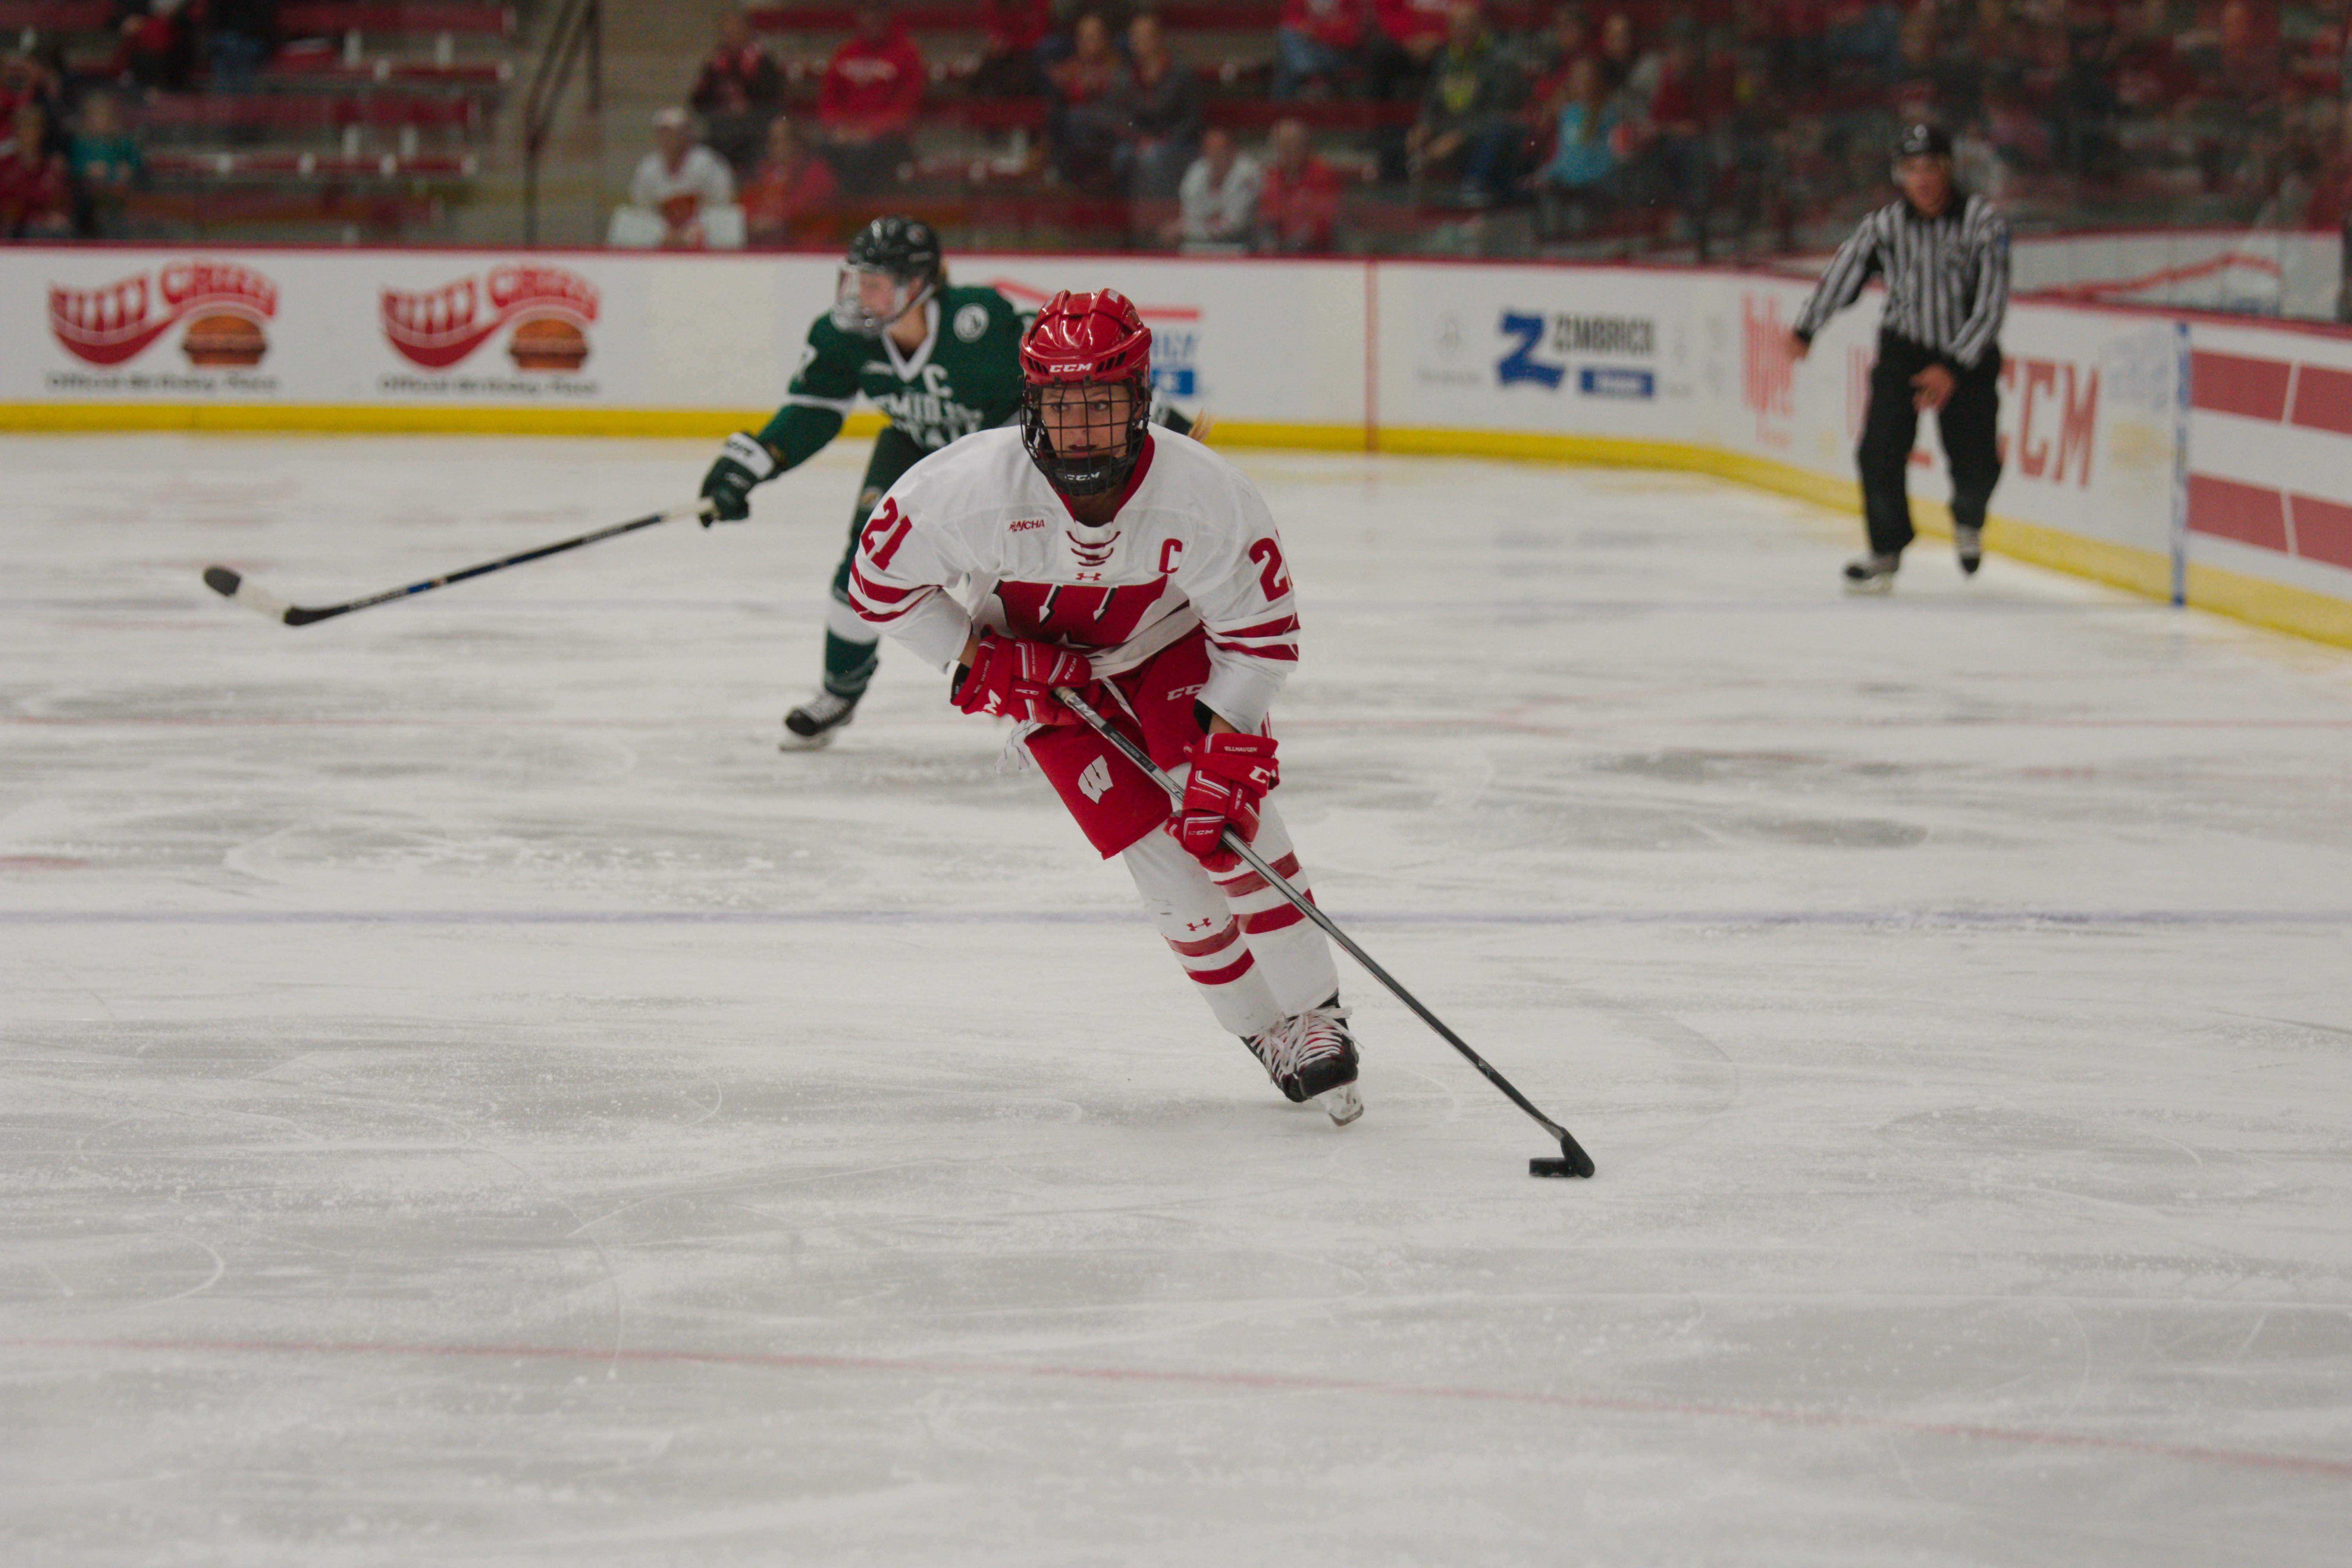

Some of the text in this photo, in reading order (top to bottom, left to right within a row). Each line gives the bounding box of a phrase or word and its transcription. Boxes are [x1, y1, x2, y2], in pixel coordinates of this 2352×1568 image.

[1049, 363, 1092, 373] CCM
[860, 496, 913, 571] 21
[1159, 538, 1183, 574] C
[1249, 537, 1293, 602] 2
[1167, 684, 1208, 701] CC
